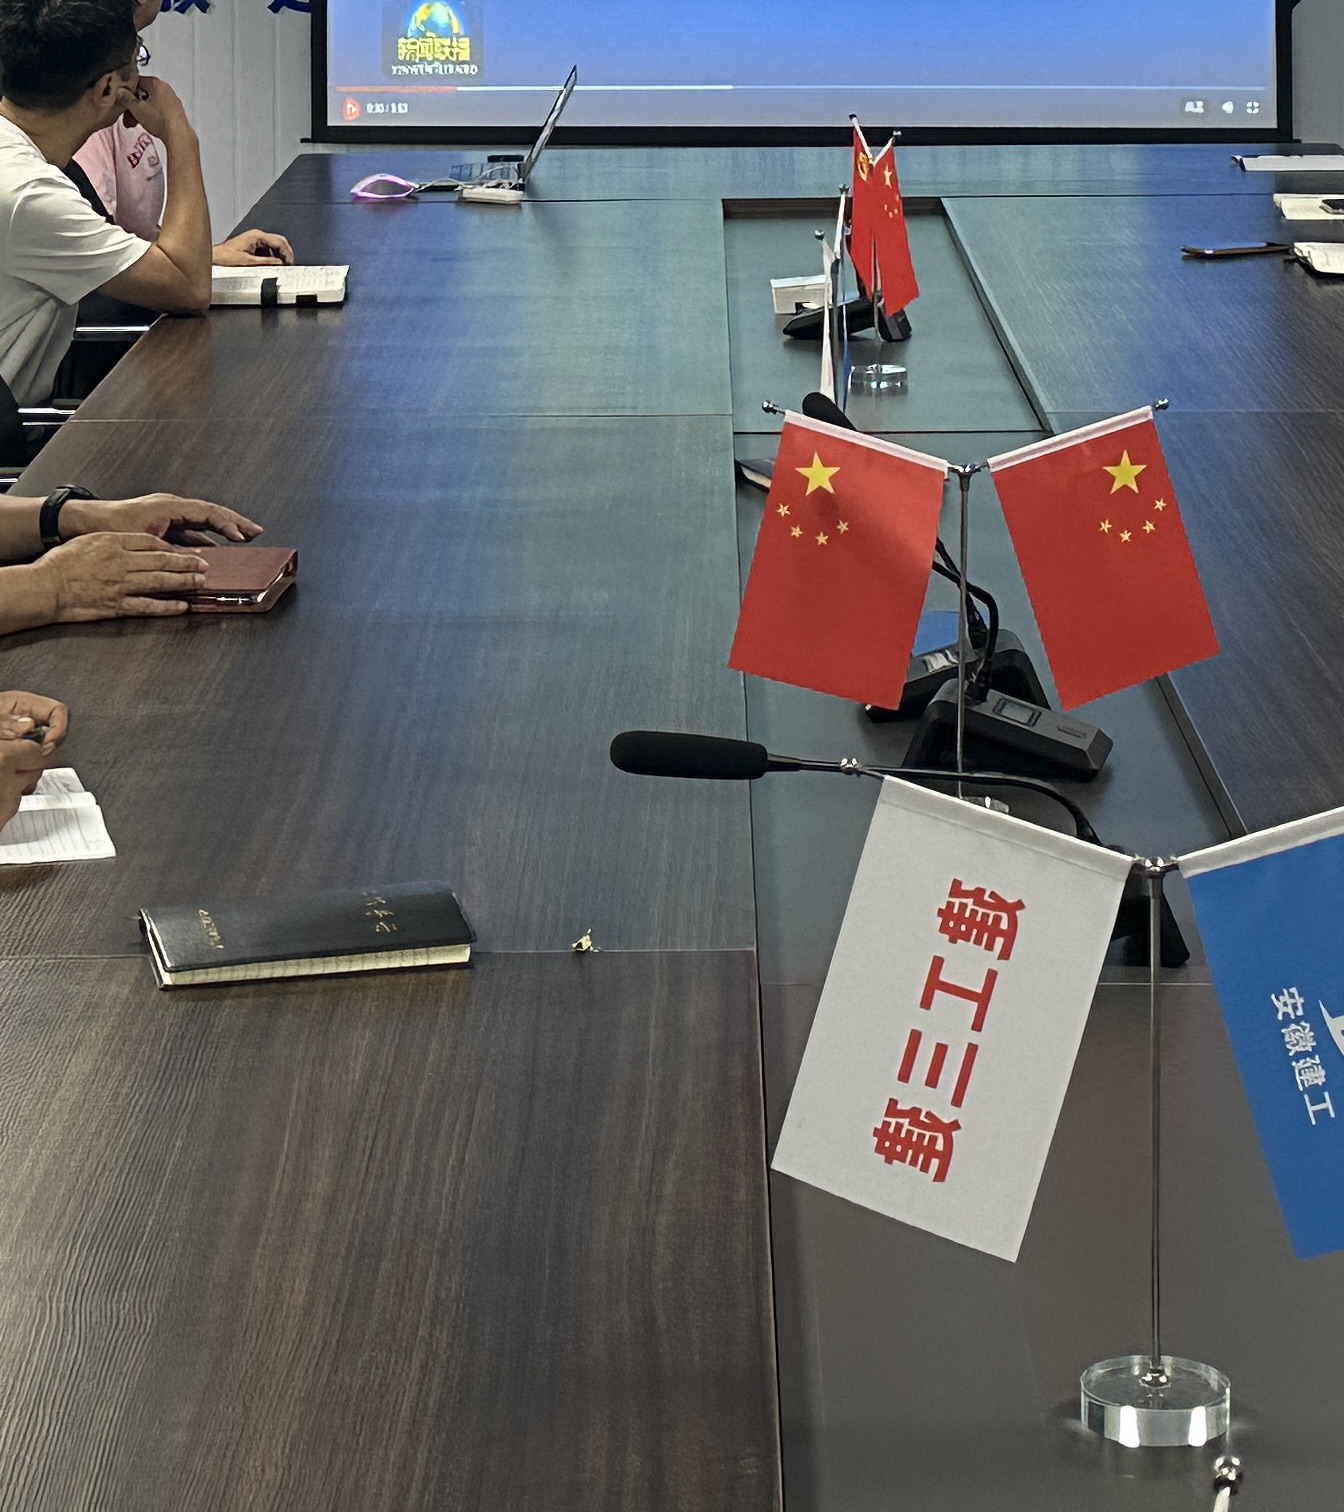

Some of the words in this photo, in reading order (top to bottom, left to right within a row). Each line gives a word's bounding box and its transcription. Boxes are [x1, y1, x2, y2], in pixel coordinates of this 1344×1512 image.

[872, 878, 1026, 1183] 建工三建
[1270, 987, 1336, 1126] 安徽建工
